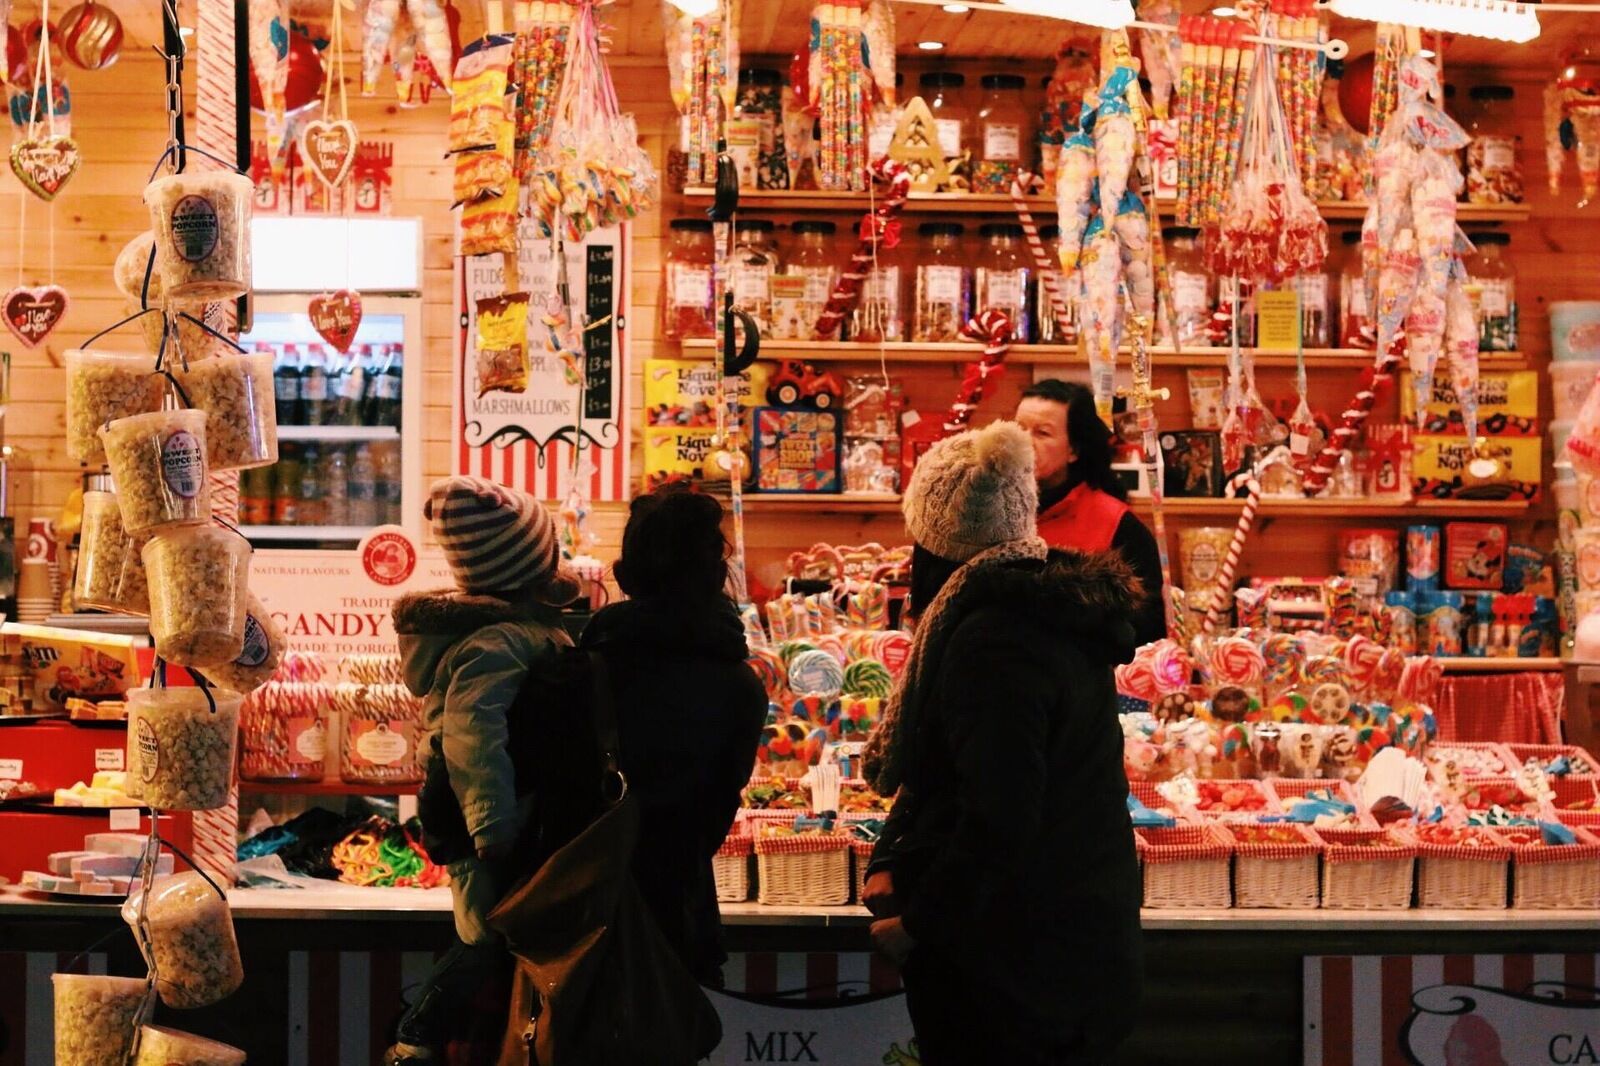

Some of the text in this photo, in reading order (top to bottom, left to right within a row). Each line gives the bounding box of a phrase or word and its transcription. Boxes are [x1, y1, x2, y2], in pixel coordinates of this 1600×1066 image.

[472, 399, 571, 416] MARSHMALLOWS
[254, 567, 351, 575] NATURAL FLAVOURS
[341, 598, 391, 607] TRADIT
[271, 612, 386, 637] CANDY
[289, 643, 400, 653] MADE TO ORIGI
[745, 1031, 819, 1063] MIX
